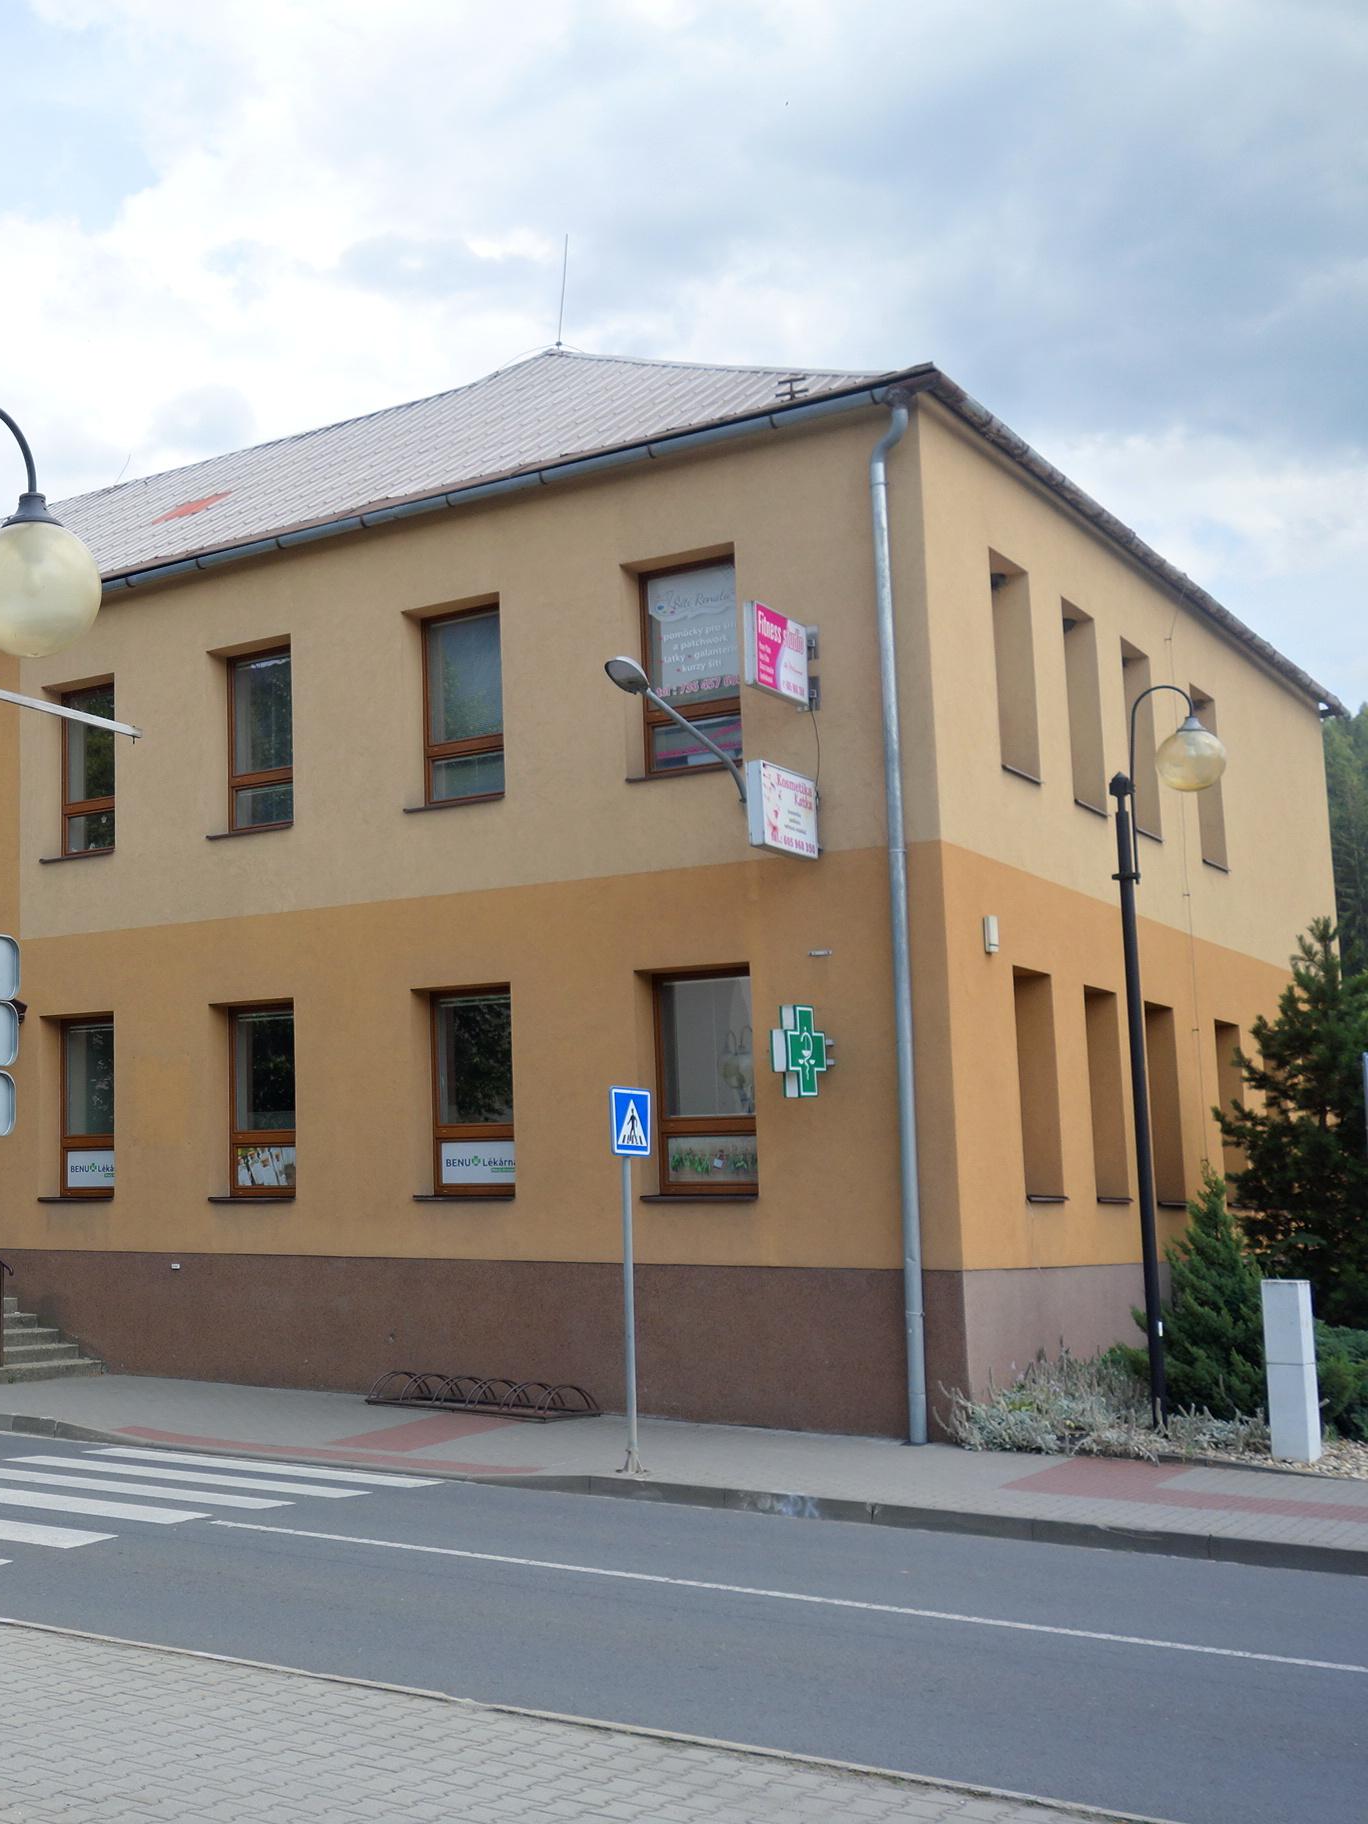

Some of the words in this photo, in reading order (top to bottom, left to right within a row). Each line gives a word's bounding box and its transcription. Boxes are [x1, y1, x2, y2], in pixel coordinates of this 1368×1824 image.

[758, 610, 782, 644] Fitness
[681, 634, 729, 650] patchwork
[682, 661, 706, 674] kurzy
[776, 774, 812, 797] Kosmetika
[445, 1158, 471, 1167] BENU
